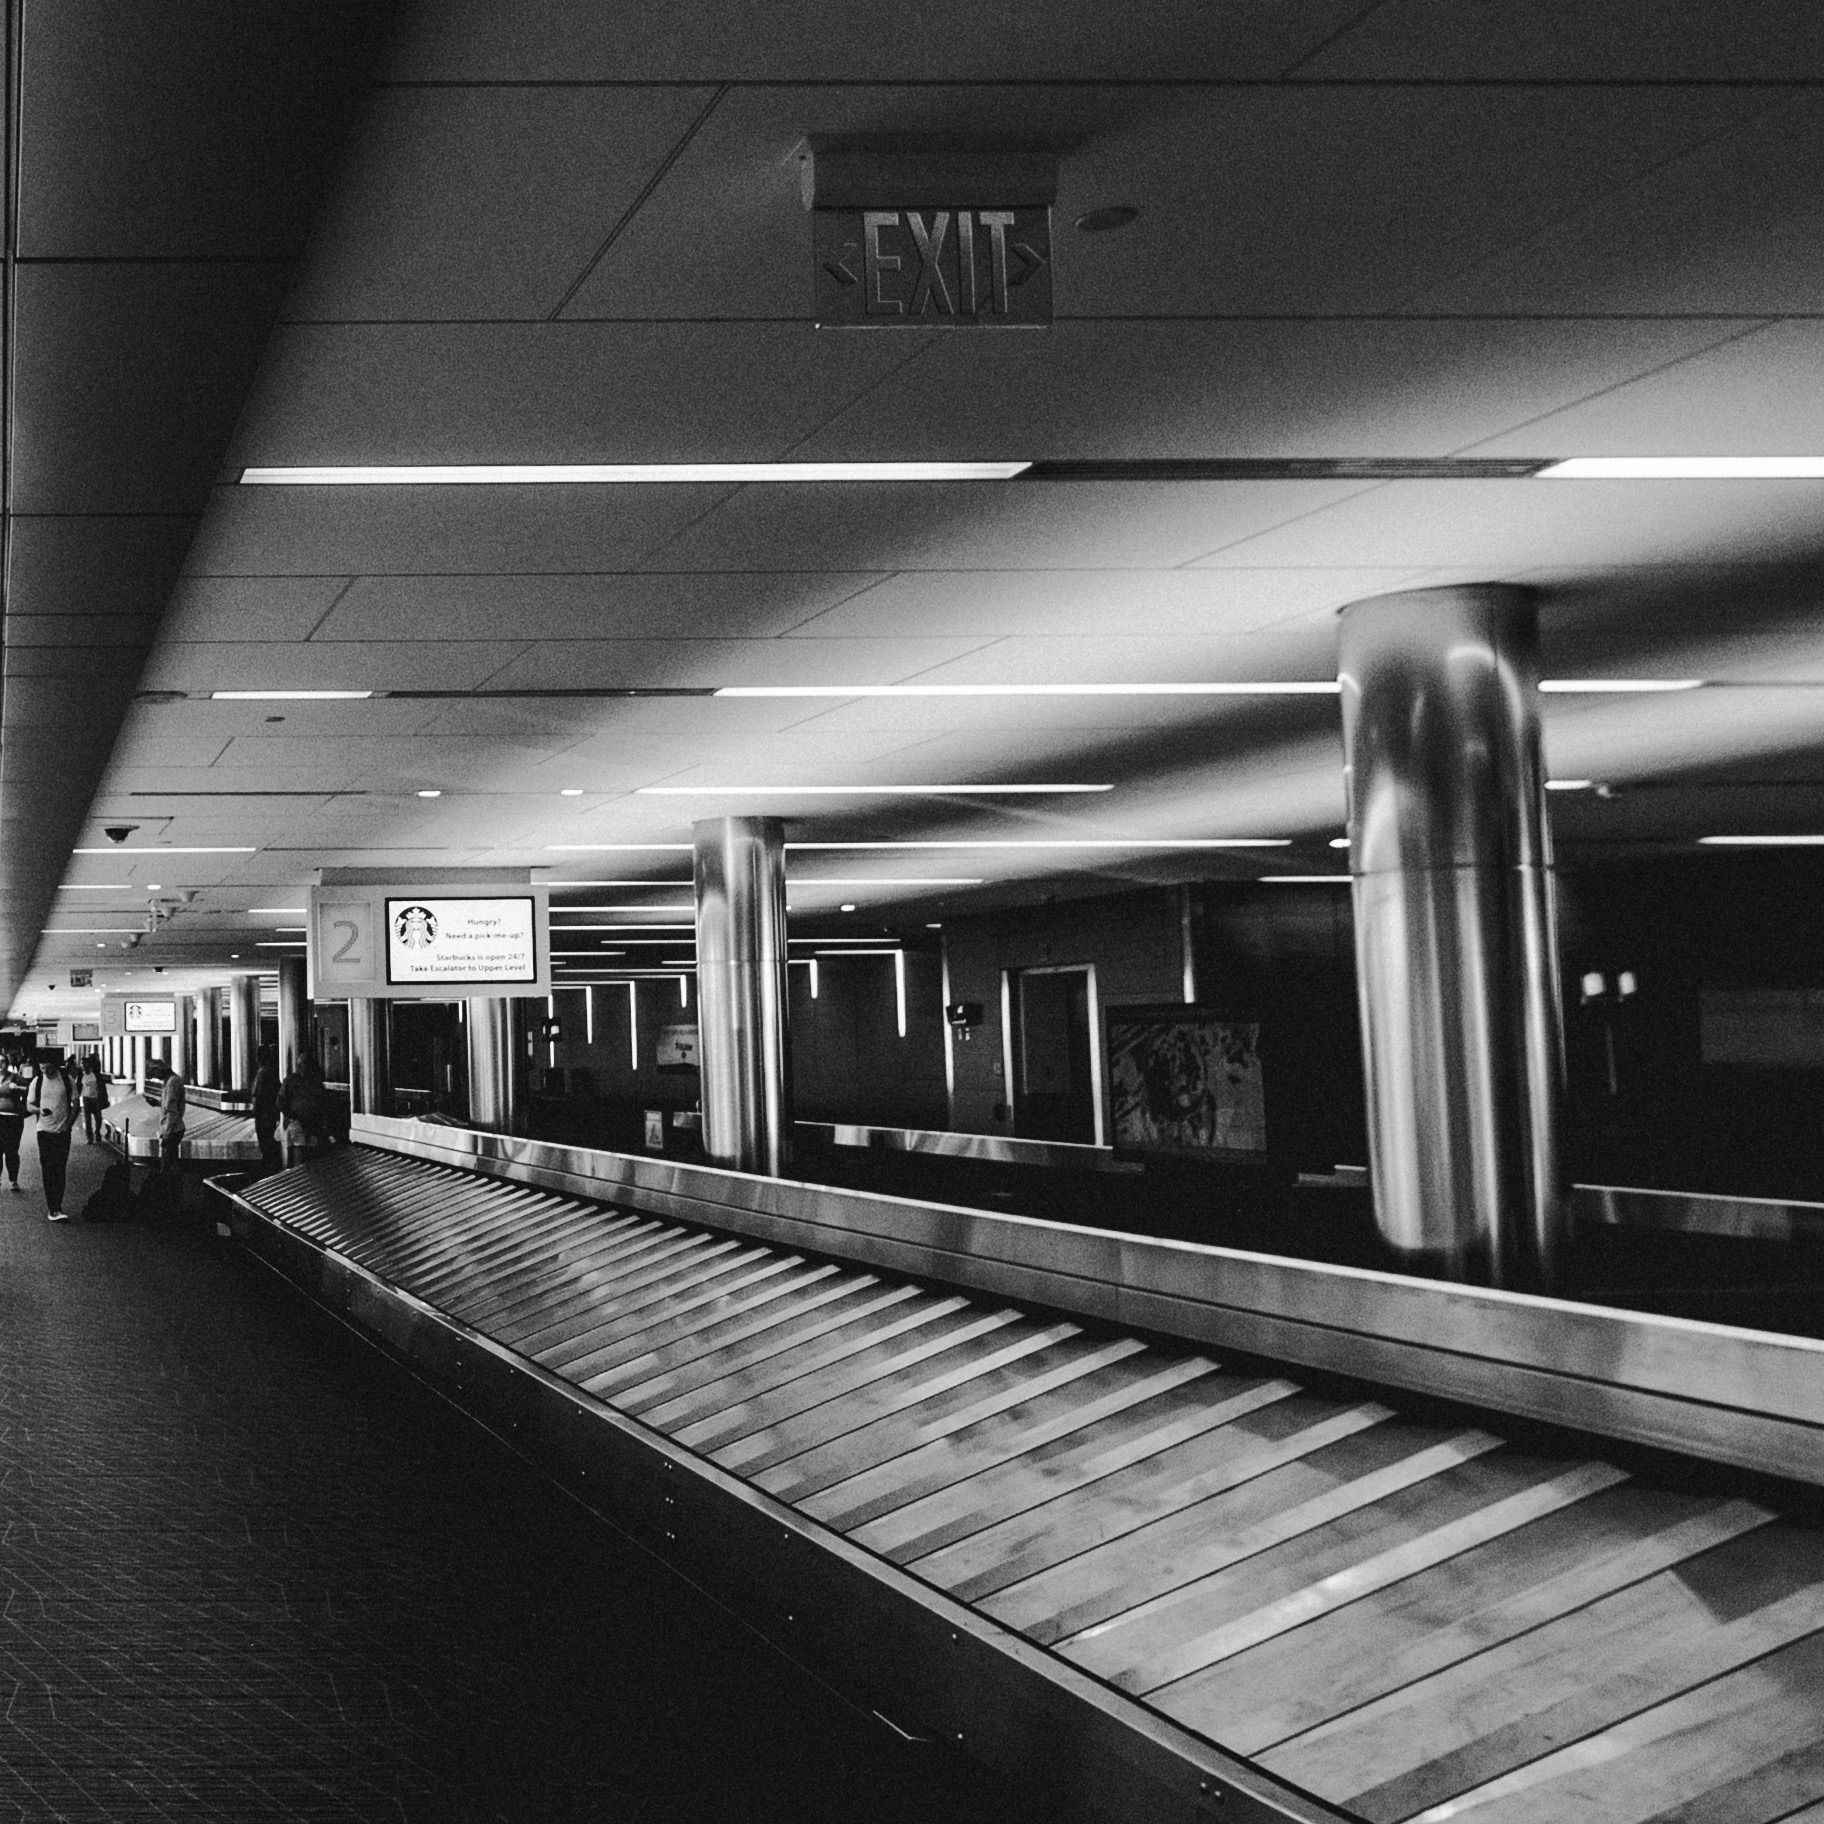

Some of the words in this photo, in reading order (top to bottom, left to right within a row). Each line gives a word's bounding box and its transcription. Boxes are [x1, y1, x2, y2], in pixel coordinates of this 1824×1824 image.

[864, 212, 1014, 314] EXIT
[467, 918, 502, 927] Hungry?
[331, 919, 361, 963] 2
[507, 952, 526, 961] 24/7
[430, 964, 467, 972] Escalator
[478, 964, 503, 974] Upper
[505, 963, 526, 972] Level
